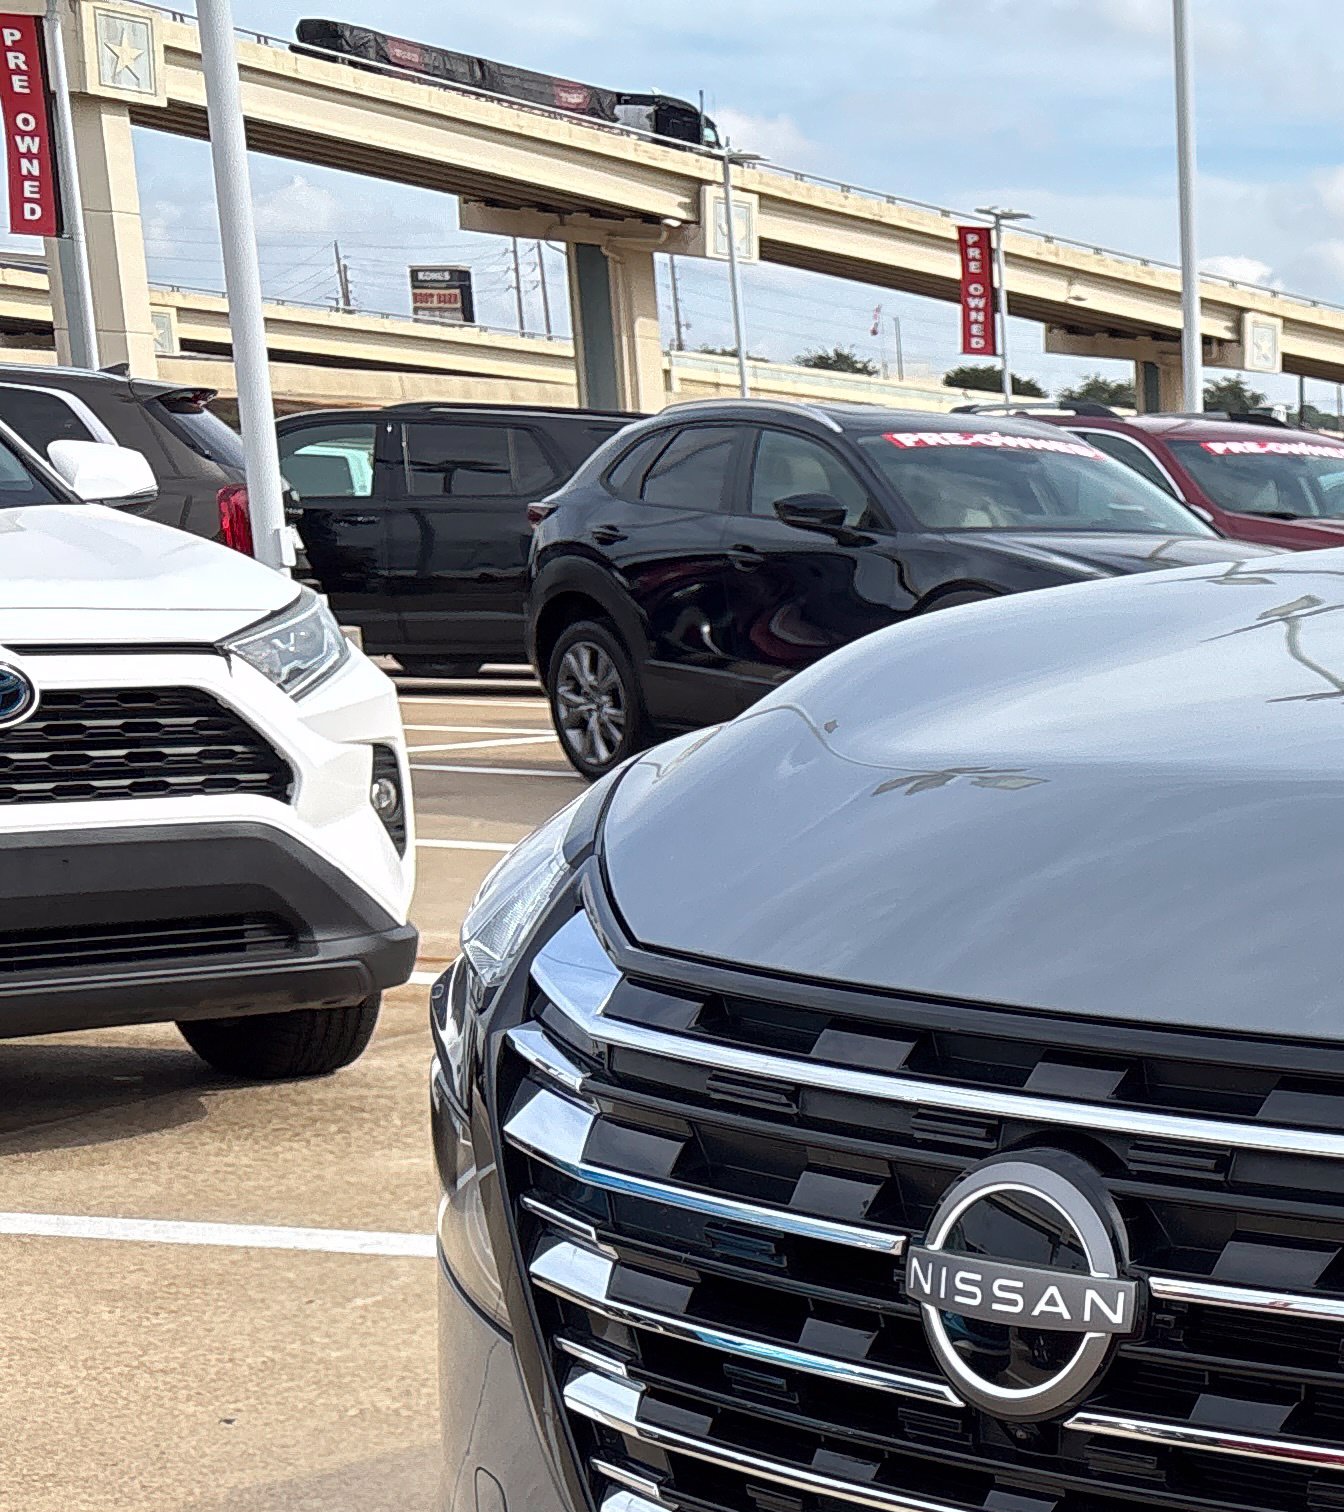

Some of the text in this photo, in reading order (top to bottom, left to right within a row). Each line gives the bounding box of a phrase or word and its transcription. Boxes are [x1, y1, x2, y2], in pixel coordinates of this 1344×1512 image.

[2, 28, 42, 220] PRE OWNED
[965, 233, 986, 349] PRE OWNED
[909, 1257, 1125, 1324] NISSAN
